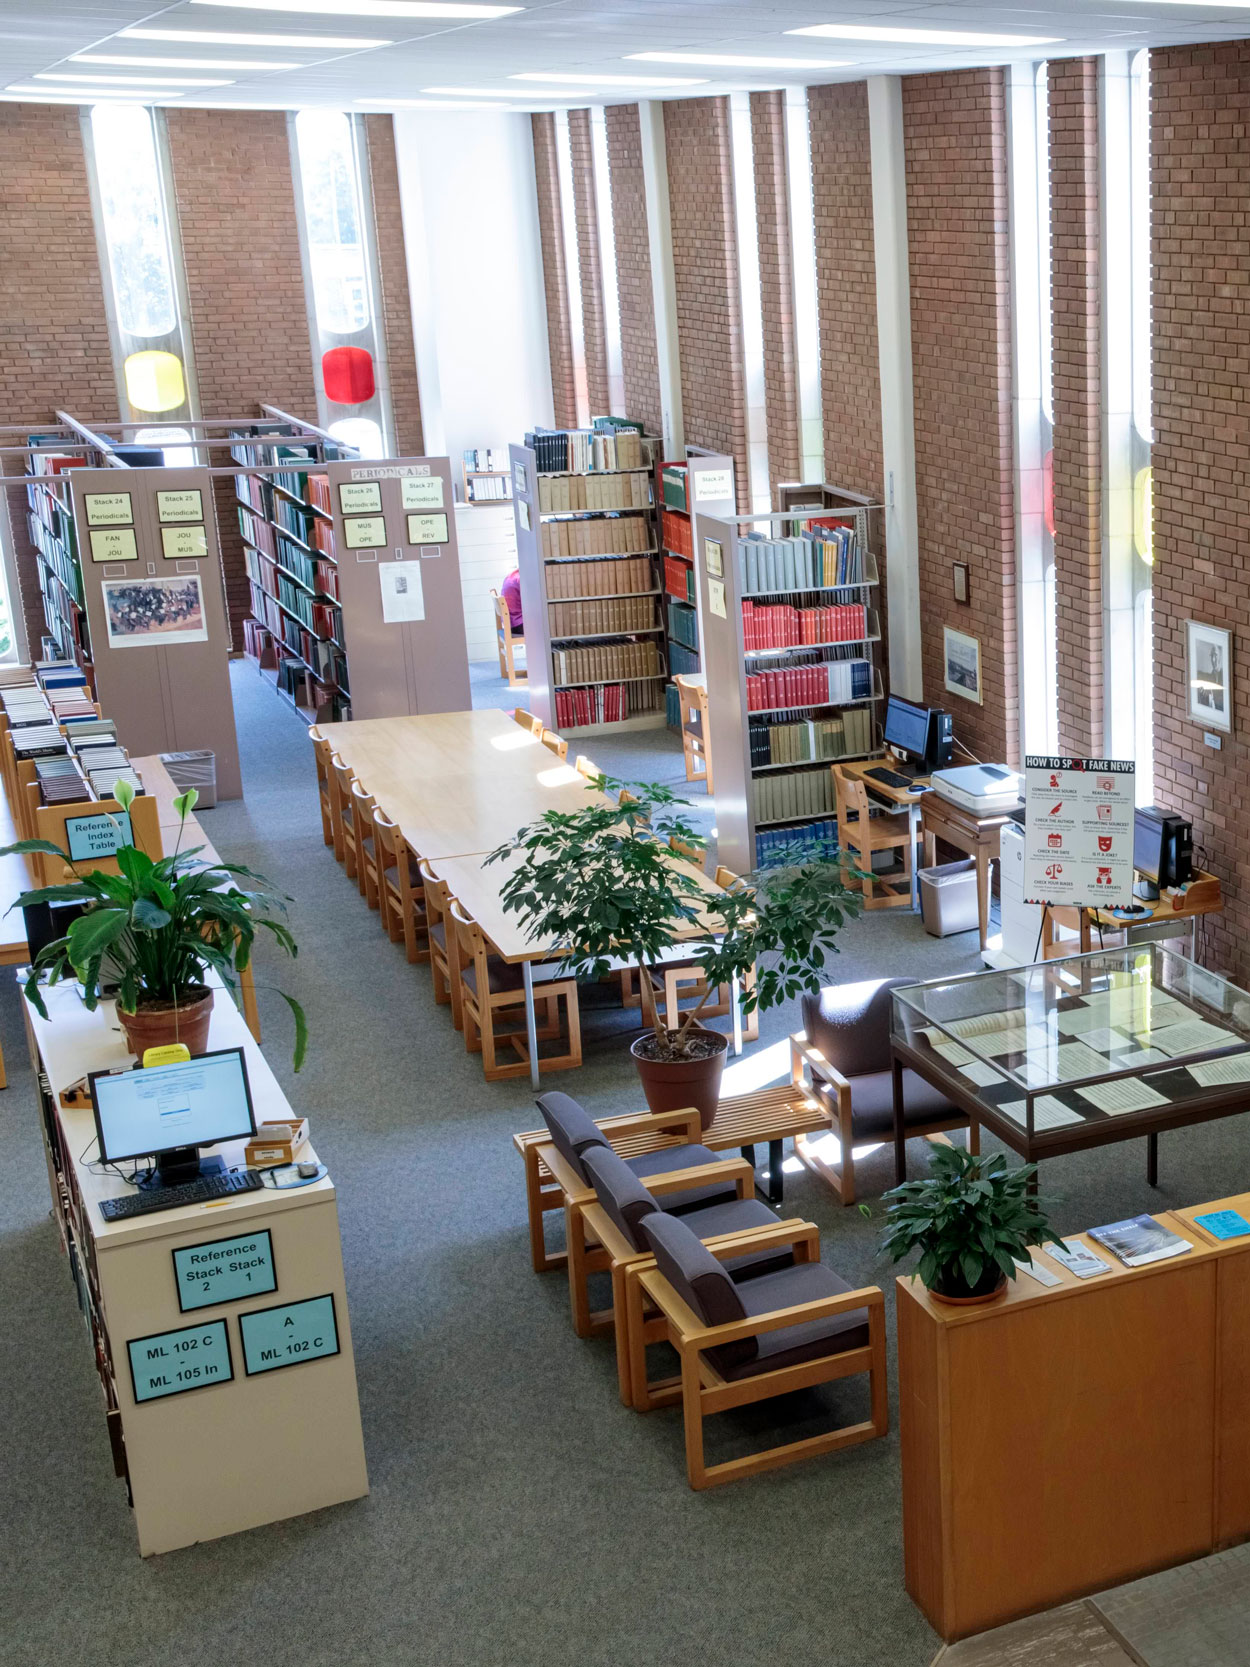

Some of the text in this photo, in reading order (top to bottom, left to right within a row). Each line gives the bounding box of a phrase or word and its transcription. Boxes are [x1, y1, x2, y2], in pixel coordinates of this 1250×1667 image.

[1026, 757, 1048, 767] HOW
[1049, 758, 1060, 768] TO
[1089, 760, 1108, 771] FAKE
[1110, 762, 1134, 772] NEWS
[75, 820, 124, 832] Referene
[87, 831, 114, 841] Index
[89, 841, 116, 850] Table
[190, 1243, 257, 1264] Reference
[186, 1256, 266, 1282] Stack Stack
[202, 1272, 252, 1292] 2 1
[284, 1316, 295, 1328] A
[146, 1335, 213, 1360] ML 102 C
[260, 1337, 324, 1361] ML 102 C
[149, 1364, 218, 1389] ML 105 In
